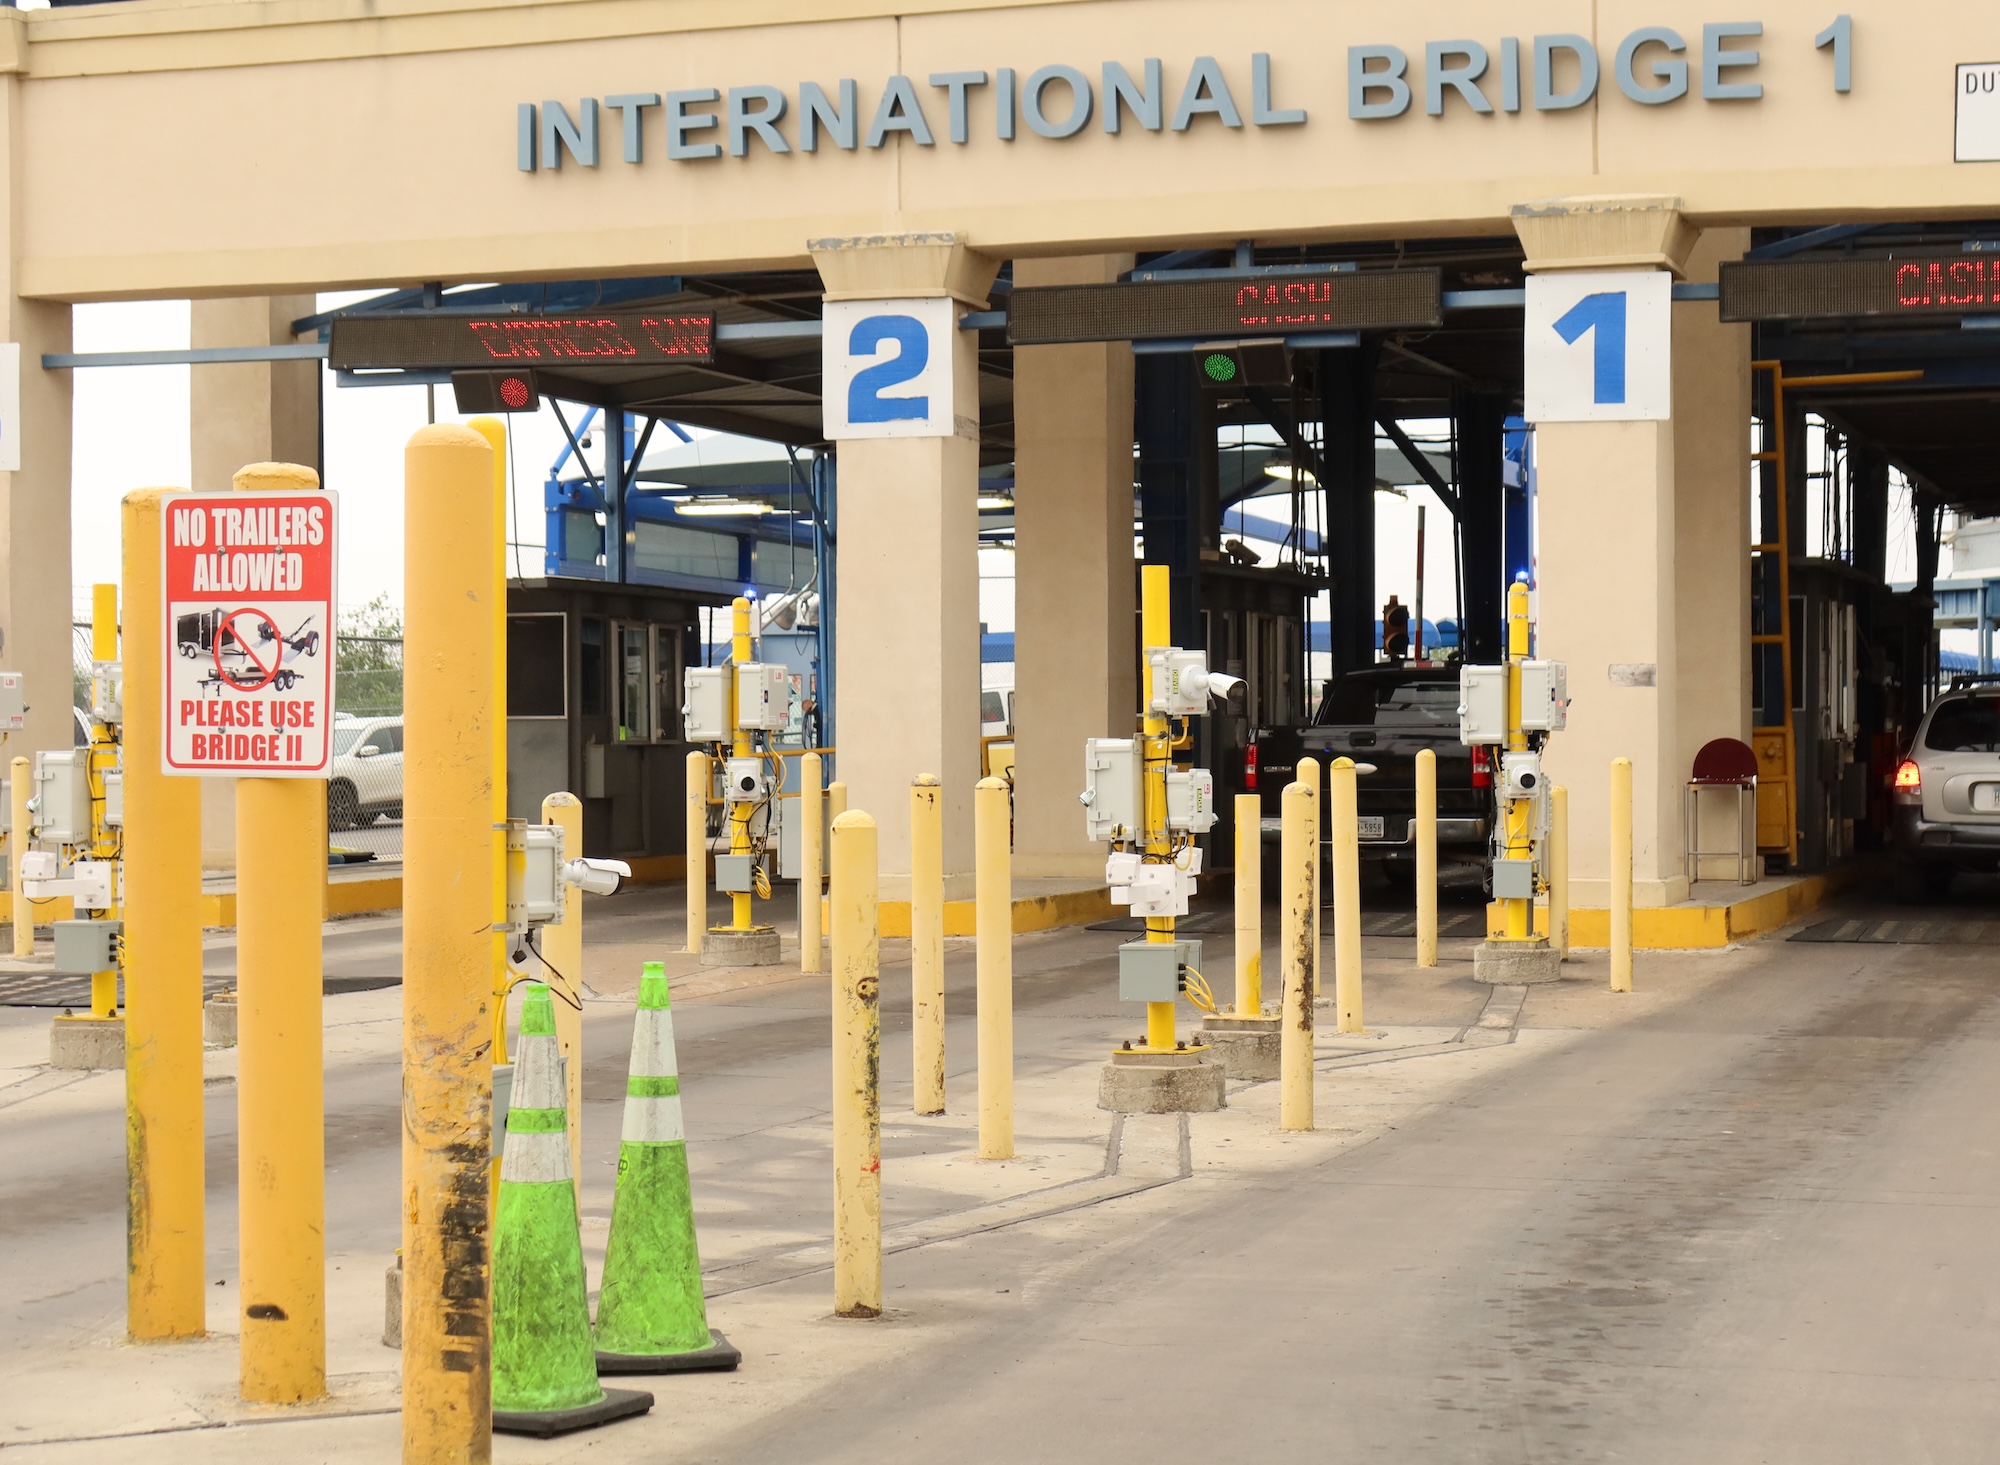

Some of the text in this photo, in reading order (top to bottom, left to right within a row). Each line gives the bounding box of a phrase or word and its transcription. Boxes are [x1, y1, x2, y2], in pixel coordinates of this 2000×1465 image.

[518, 14, 1852, 172] INTERNATIONAL BRIDGE 1
[1966, 71, 2000, 94] DU
[1896, 261, 2000, 306] CASH
[1551, 291, 1627, 404] 1
[847, 315, 929, 424] 2
[174, 506, 324, 547] NO TRAILERS
[193, 552, 303, 592] ALLOWED
[181, 700, 315, 728] PLEASE USE
[192, 734, 303, 761] BRIDGE II
